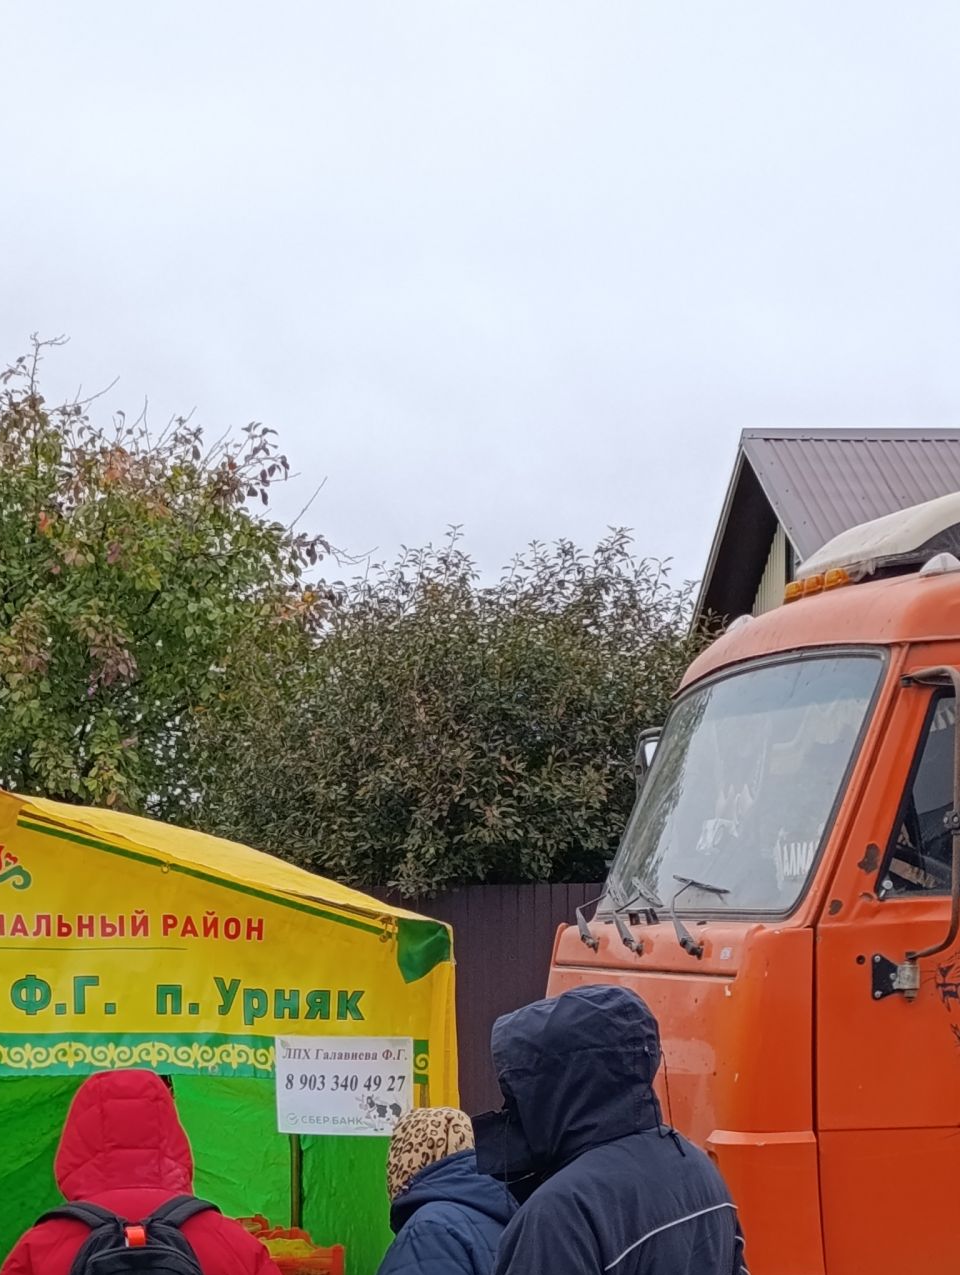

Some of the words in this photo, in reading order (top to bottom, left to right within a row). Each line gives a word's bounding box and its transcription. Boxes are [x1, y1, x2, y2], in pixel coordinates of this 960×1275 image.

[161, 910, 265, 942] РАЙОН
[9, 973, 117, 1016] Ф.Г.
[155, 983, 200, 1016] п.
[213, 976, 366, 1025] Урняк
[282, 1048, 311, 1060] ЛПХ
[315, 1048, 378, 1061] Галавиева
[381, 1049, 408, 1061] Ф.Г.
[285, 1073, 295, 1090] 8
[299, 1073, 326, 1091] 903
[330, 1074, 359, 1092] 340
[363, 1075, 382, 1092] 49
[386, 1075, 406, 1092] 27
